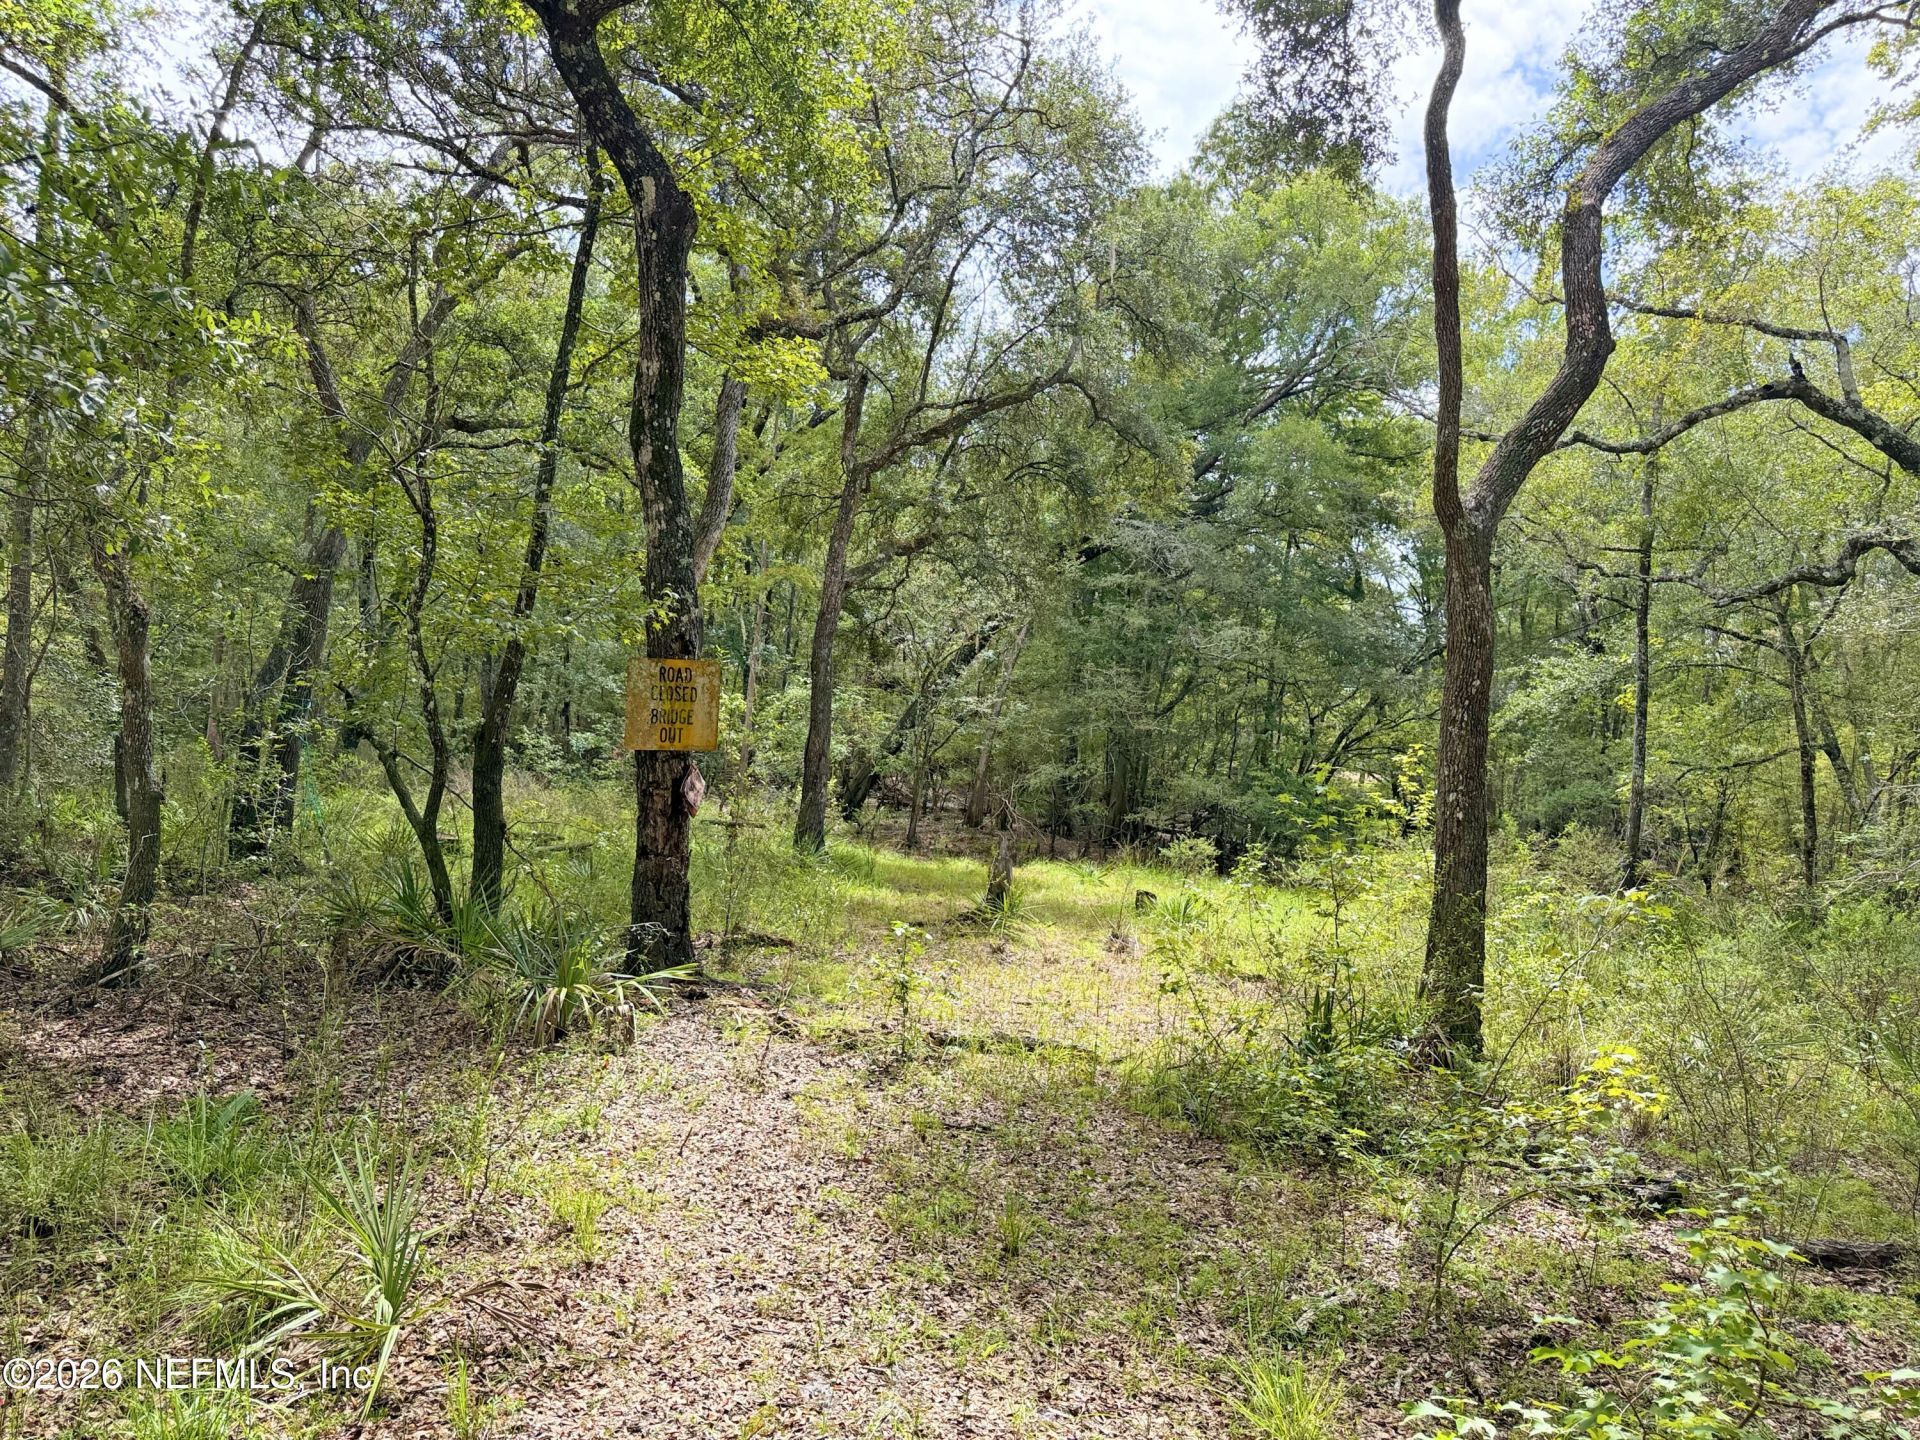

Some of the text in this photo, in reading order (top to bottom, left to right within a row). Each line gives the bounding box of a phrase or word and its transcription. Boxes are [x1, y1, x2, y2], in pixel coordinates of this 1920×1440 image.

[659, 666, 693, 683] ROAD
[651, 685, 698, 703] CLOSED
[650, 708, 694, 725] BRIDGE
[659, 727, 684, 744] OUT
